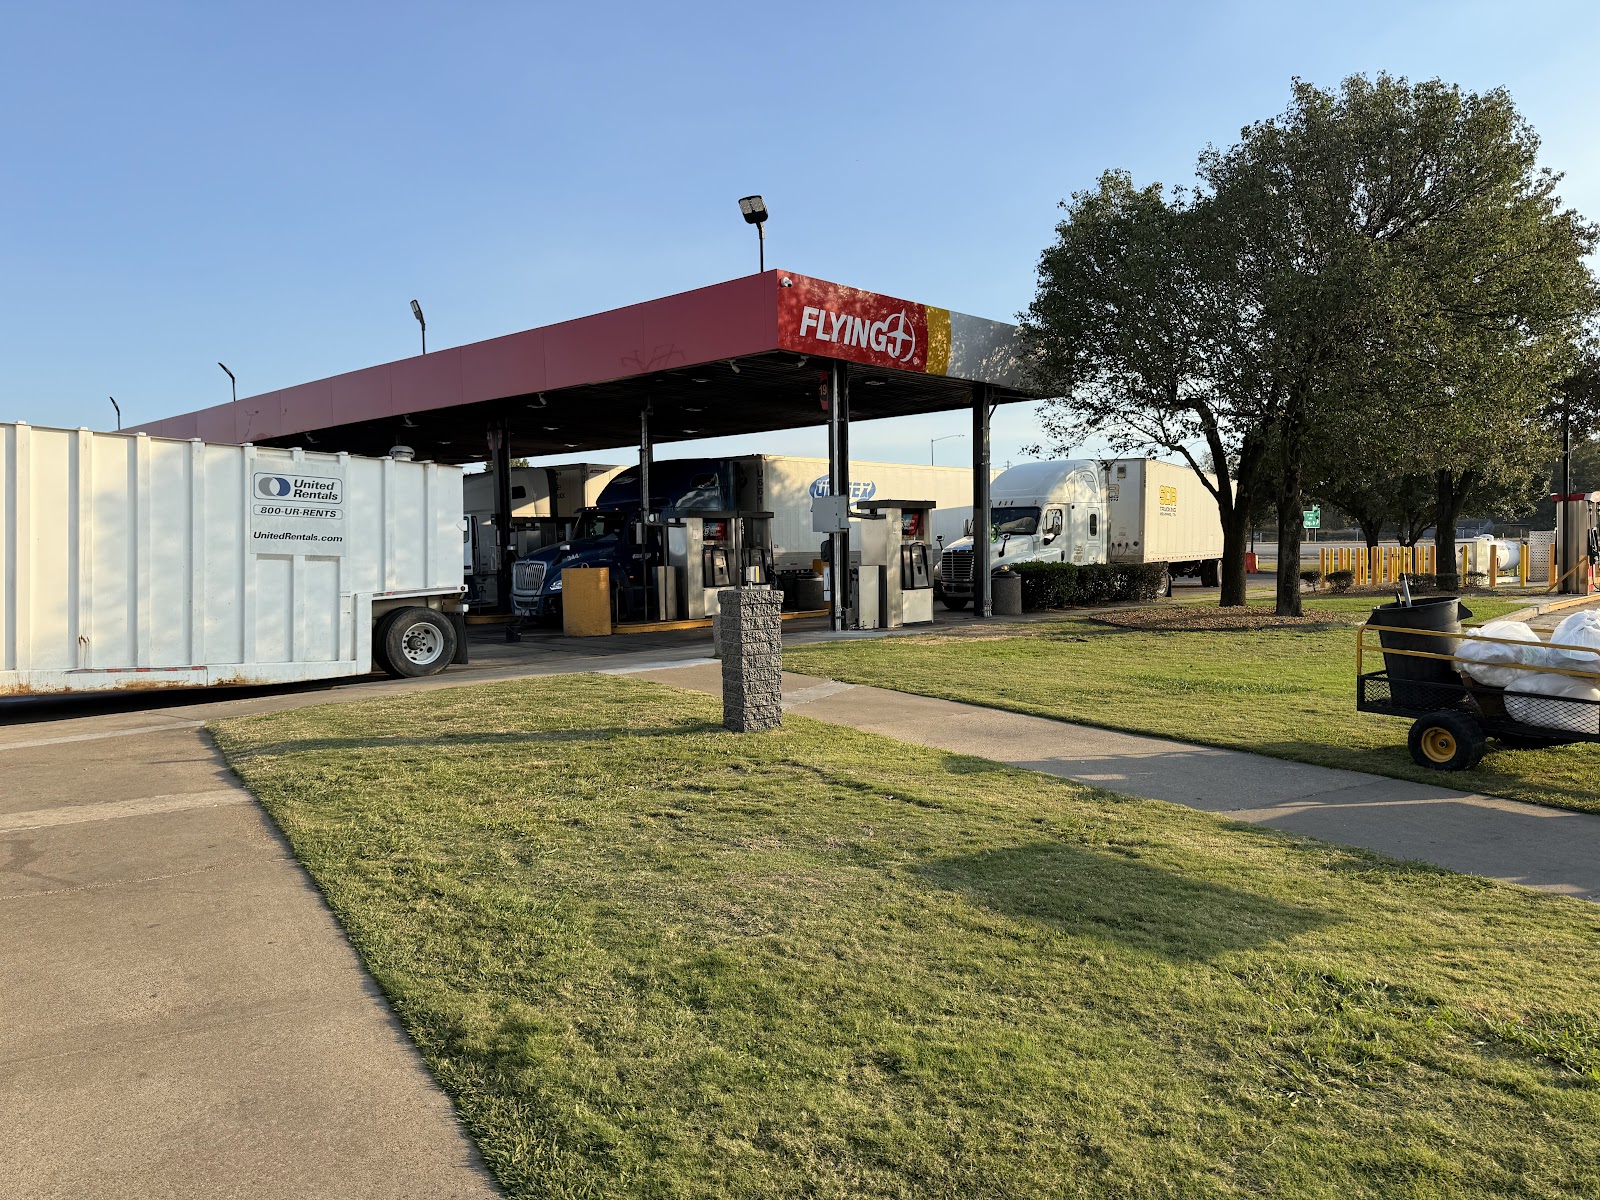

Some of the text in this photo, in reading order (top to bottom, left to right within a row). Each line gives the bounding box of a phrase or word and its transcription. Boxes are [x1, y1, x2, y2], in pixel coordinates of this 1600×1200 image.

[800, 306, 887, 352] FLYING
[294, 479, 335, 491] United
[293, 489, 338, 501] Rentals
[260, 506, 337, 518] 800-UR-RENTS
[253, 531, 343, 542] UnitedRentals.com
